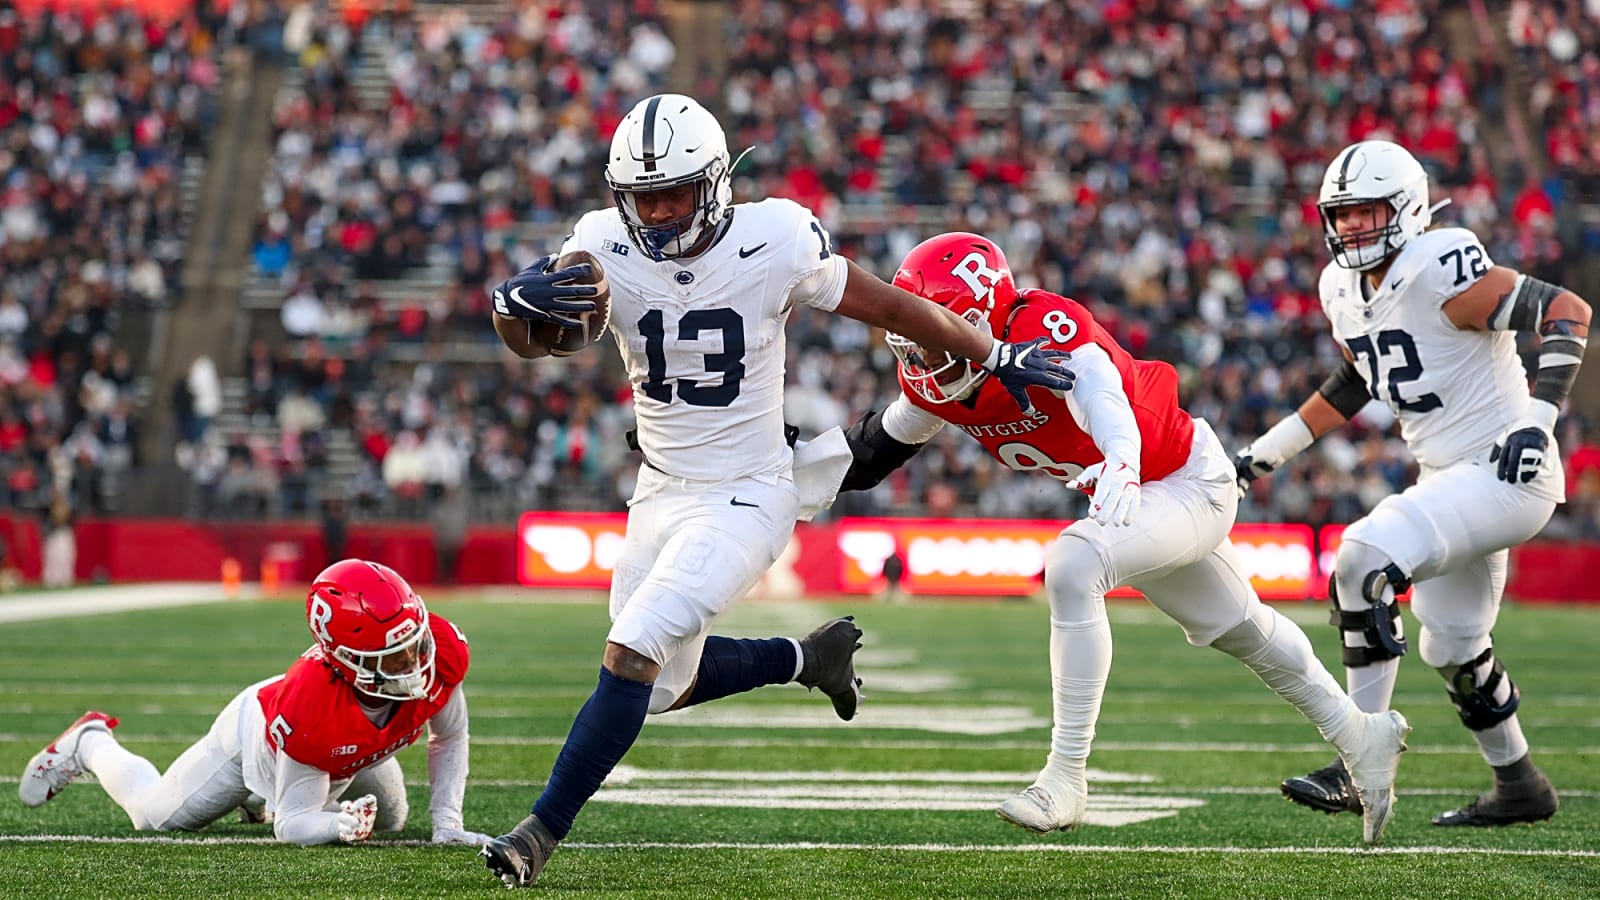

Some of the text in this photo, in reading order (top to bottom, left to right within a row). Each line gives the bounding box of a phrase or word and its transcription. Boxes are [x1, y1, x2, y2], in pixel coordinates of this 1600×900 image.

[810, 221, 832, 260] 1
[951, 252, 1002, 302] R
[1438, 245, 1488, 287] 72
[1042, 310, 1078, 344] 8
[637, 307, 745, 407] 13
[1345, 328, 1444, 413] 72
[309, 593, 333, 643] R
[270, 713, 293, 750] 5
